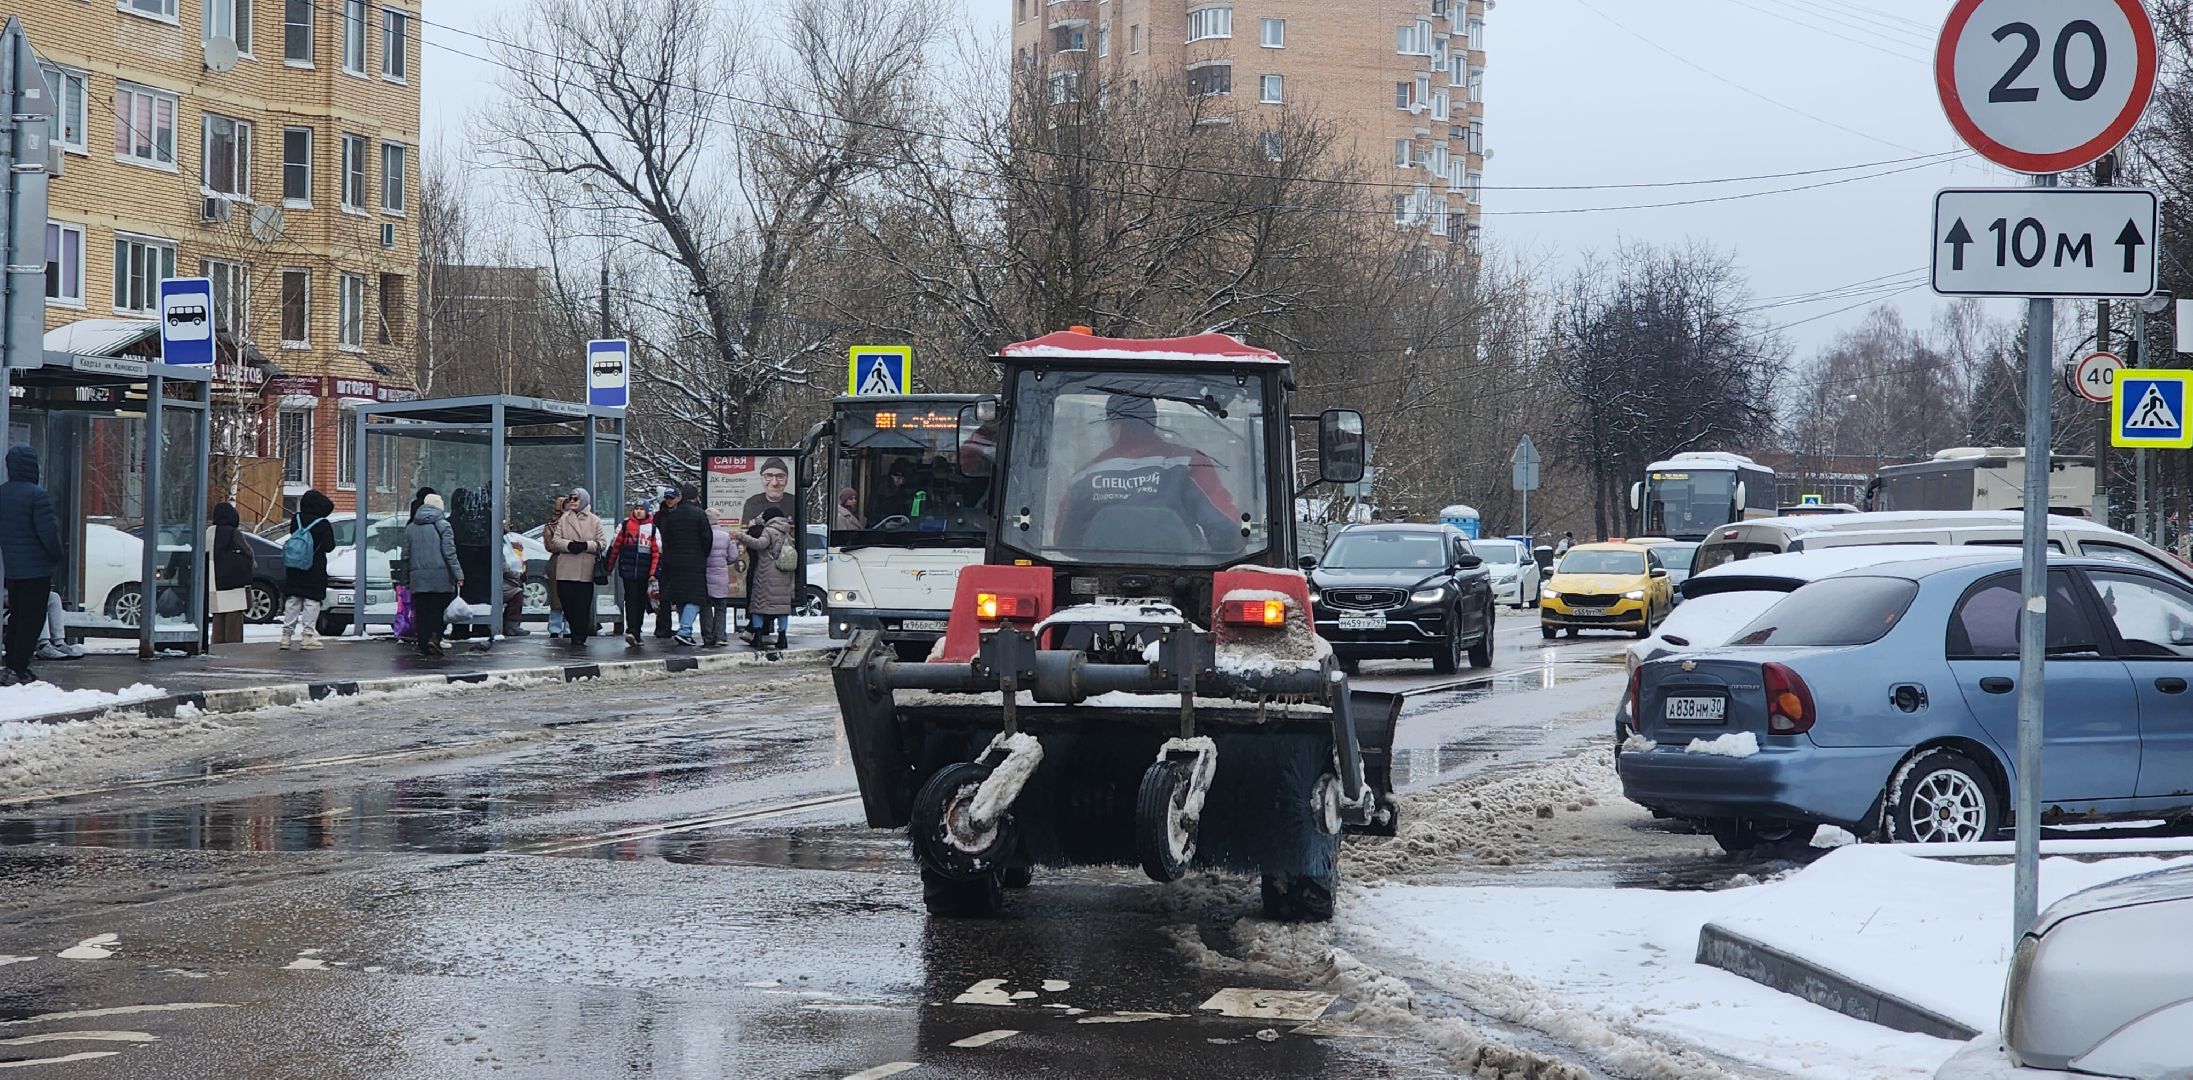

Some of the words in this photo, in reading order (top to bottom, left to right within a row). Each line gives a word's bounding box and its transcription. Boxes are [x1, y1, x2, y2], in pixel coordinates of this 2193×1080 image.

[1988, 19, 2107, 103] 20
[2087, 367, 2113, 385] 40
[336, 380, 374, 396] ШТОРЫ
[714, 456, 747, 465] САТЬЯ
[721, 476, 747, 484] Ершово
[1669, 699, 1709, 718] А838НМ
[1711, 699, 1721, 713] 30
